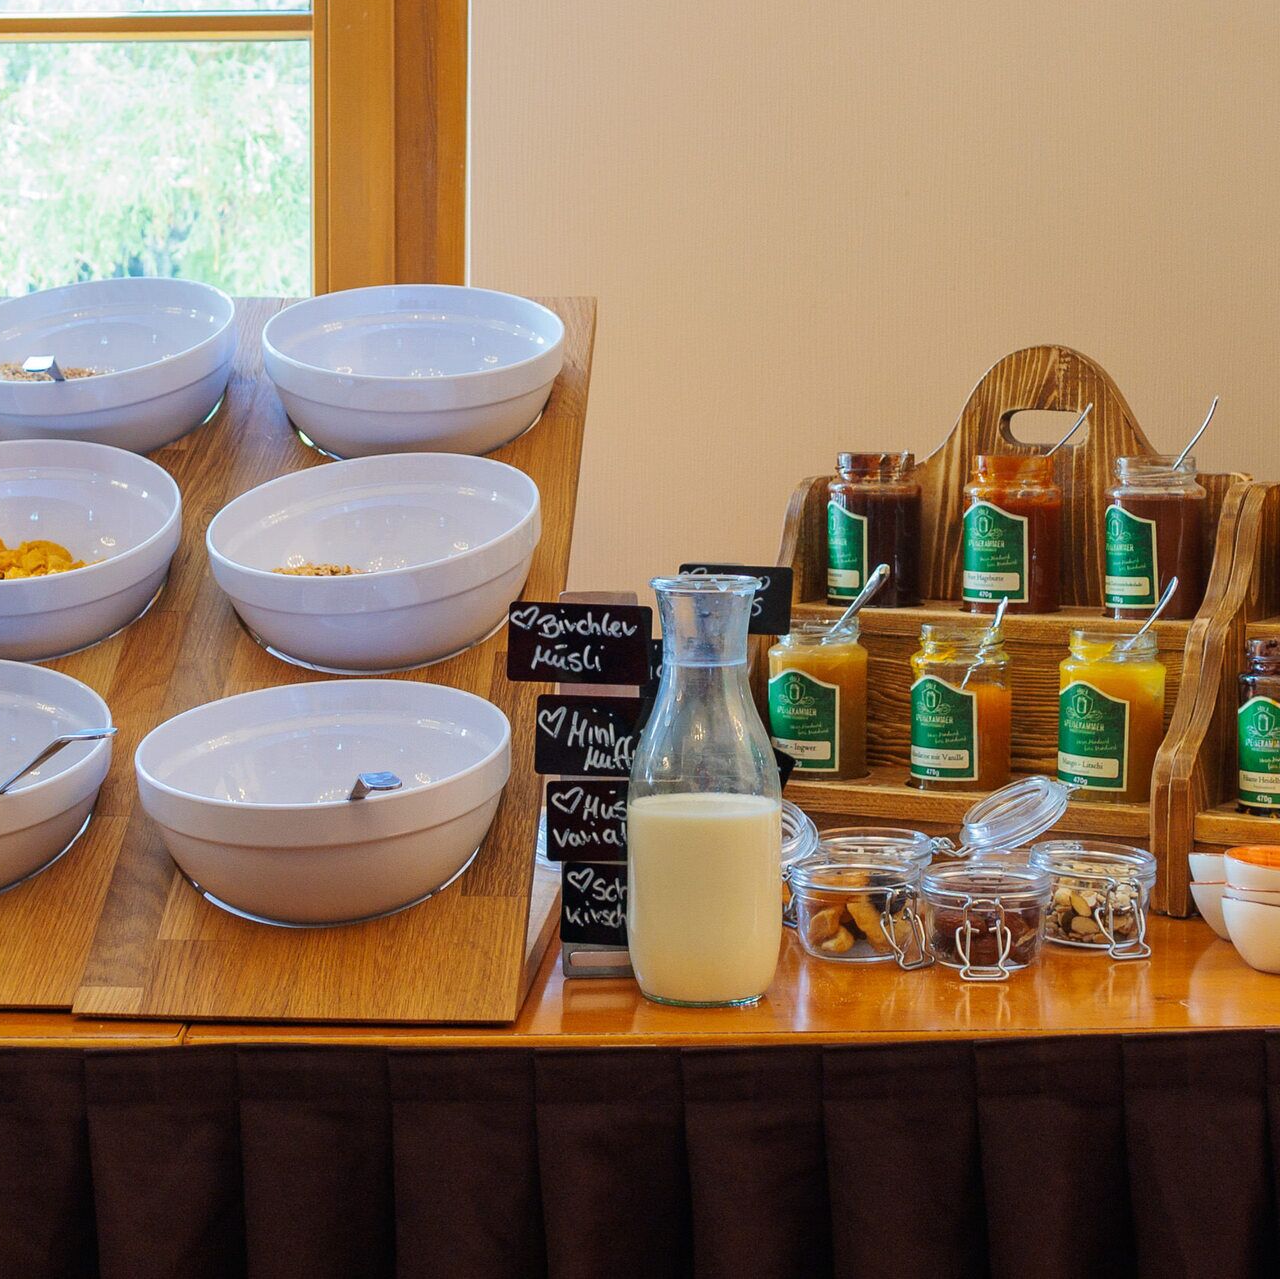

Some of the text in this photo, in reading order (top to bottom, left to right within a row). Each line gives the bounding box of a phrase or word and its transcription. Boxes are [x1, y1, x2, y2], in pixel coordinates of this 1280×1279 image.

[530, 643, 606, 672] Müsli
[567, 707, 616, 748] Mini
[794, 743, 817, 753] Ingwer
[925, 767, 941, 778] 470g
[1072, 775, 1089, 786] 470g
[582, 790, 627, 821] Müs
[1256, 794, 1273, 804] 470g
[592, 876, 627, 902] Sch
